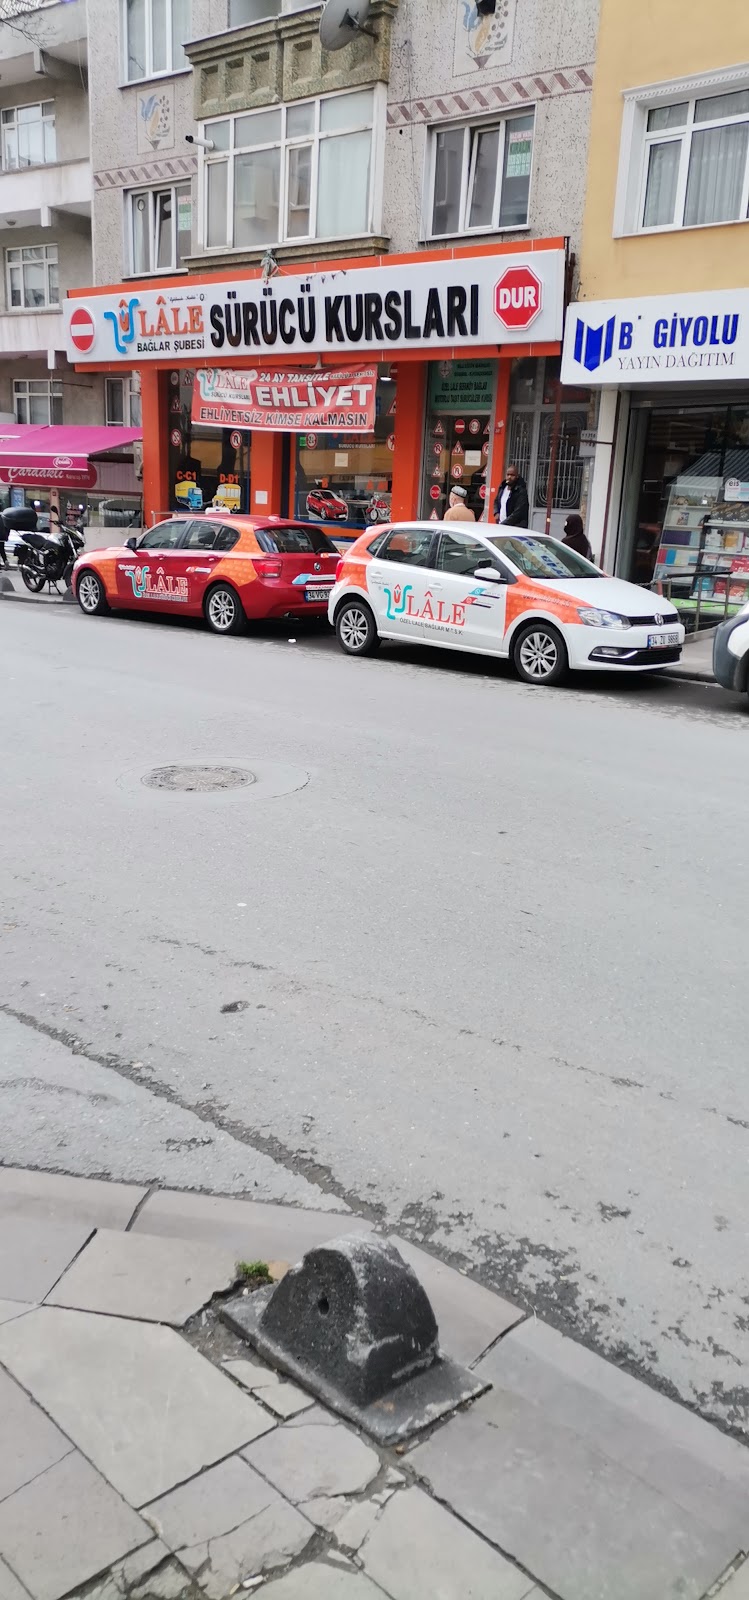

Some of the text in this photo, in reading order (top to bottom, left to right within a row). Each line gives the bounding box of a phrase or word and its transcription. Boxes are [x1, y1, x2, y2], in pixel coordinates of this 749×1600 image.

[499, 285, 537, 311] DUR
[138, 295, 204, 337] LÂLE
[209, 283, 479, 348] SÜRÜCÜ KURSLARI
[137, 336, 205, 353] BAĞLAR ŞUBESİ
[618, 352, 736, 371] YAYIN DAĞITIM
[258, 372, 270, 382] 24
[271, 373, 286, 383] AY
[255, 381, 372, 407] EHLİYET
[200, 405, 368, 426] EHLİYETSİZ KİMSE KALMASIN
[176, 471, 197, 480] C-C1
[219, 473, 239, 483] D-D1
[145, 566, 189, 597] LÂLE
[406, 590, 466, 627] LÂLE
